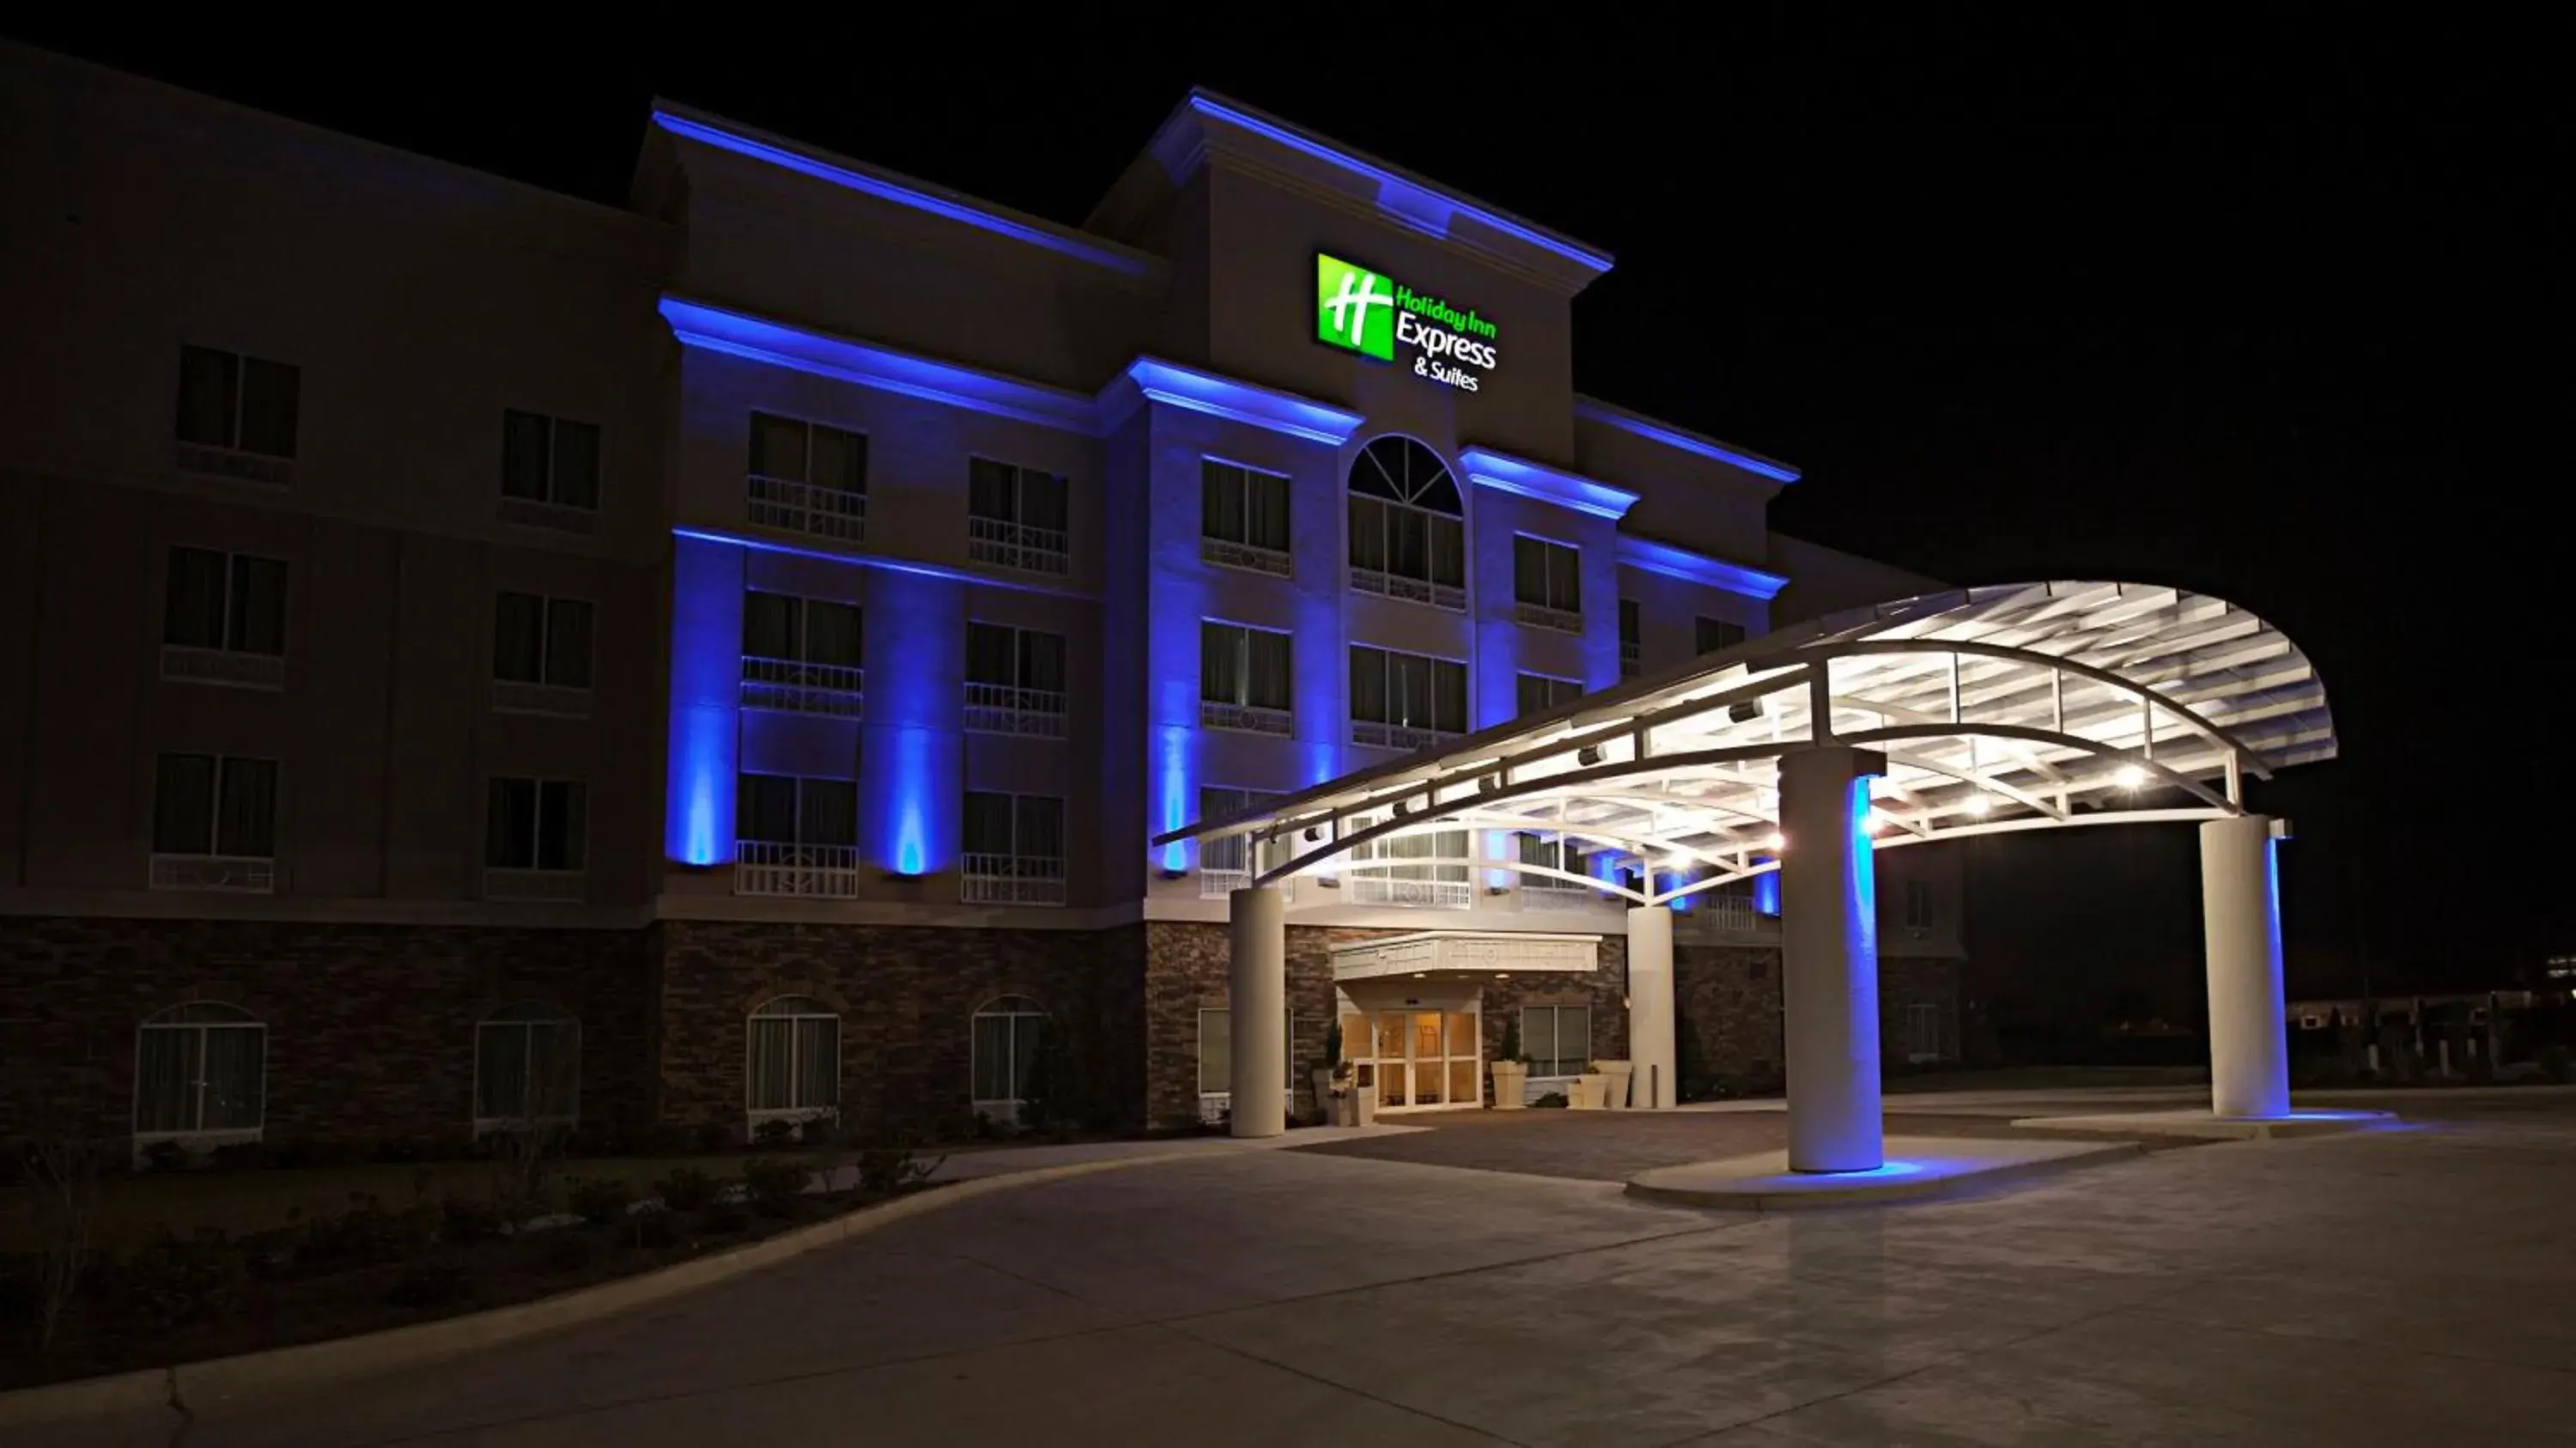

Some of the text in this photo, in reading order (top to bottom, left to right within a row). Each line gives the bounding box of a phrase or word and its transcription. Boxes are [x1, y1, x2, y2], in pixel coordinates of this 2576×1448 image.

[1396, 285, 1497, 338] Holiday Inn
[1396, 310, 1497, 369] Express
[1414, 356, 1479, 392] & Suites
